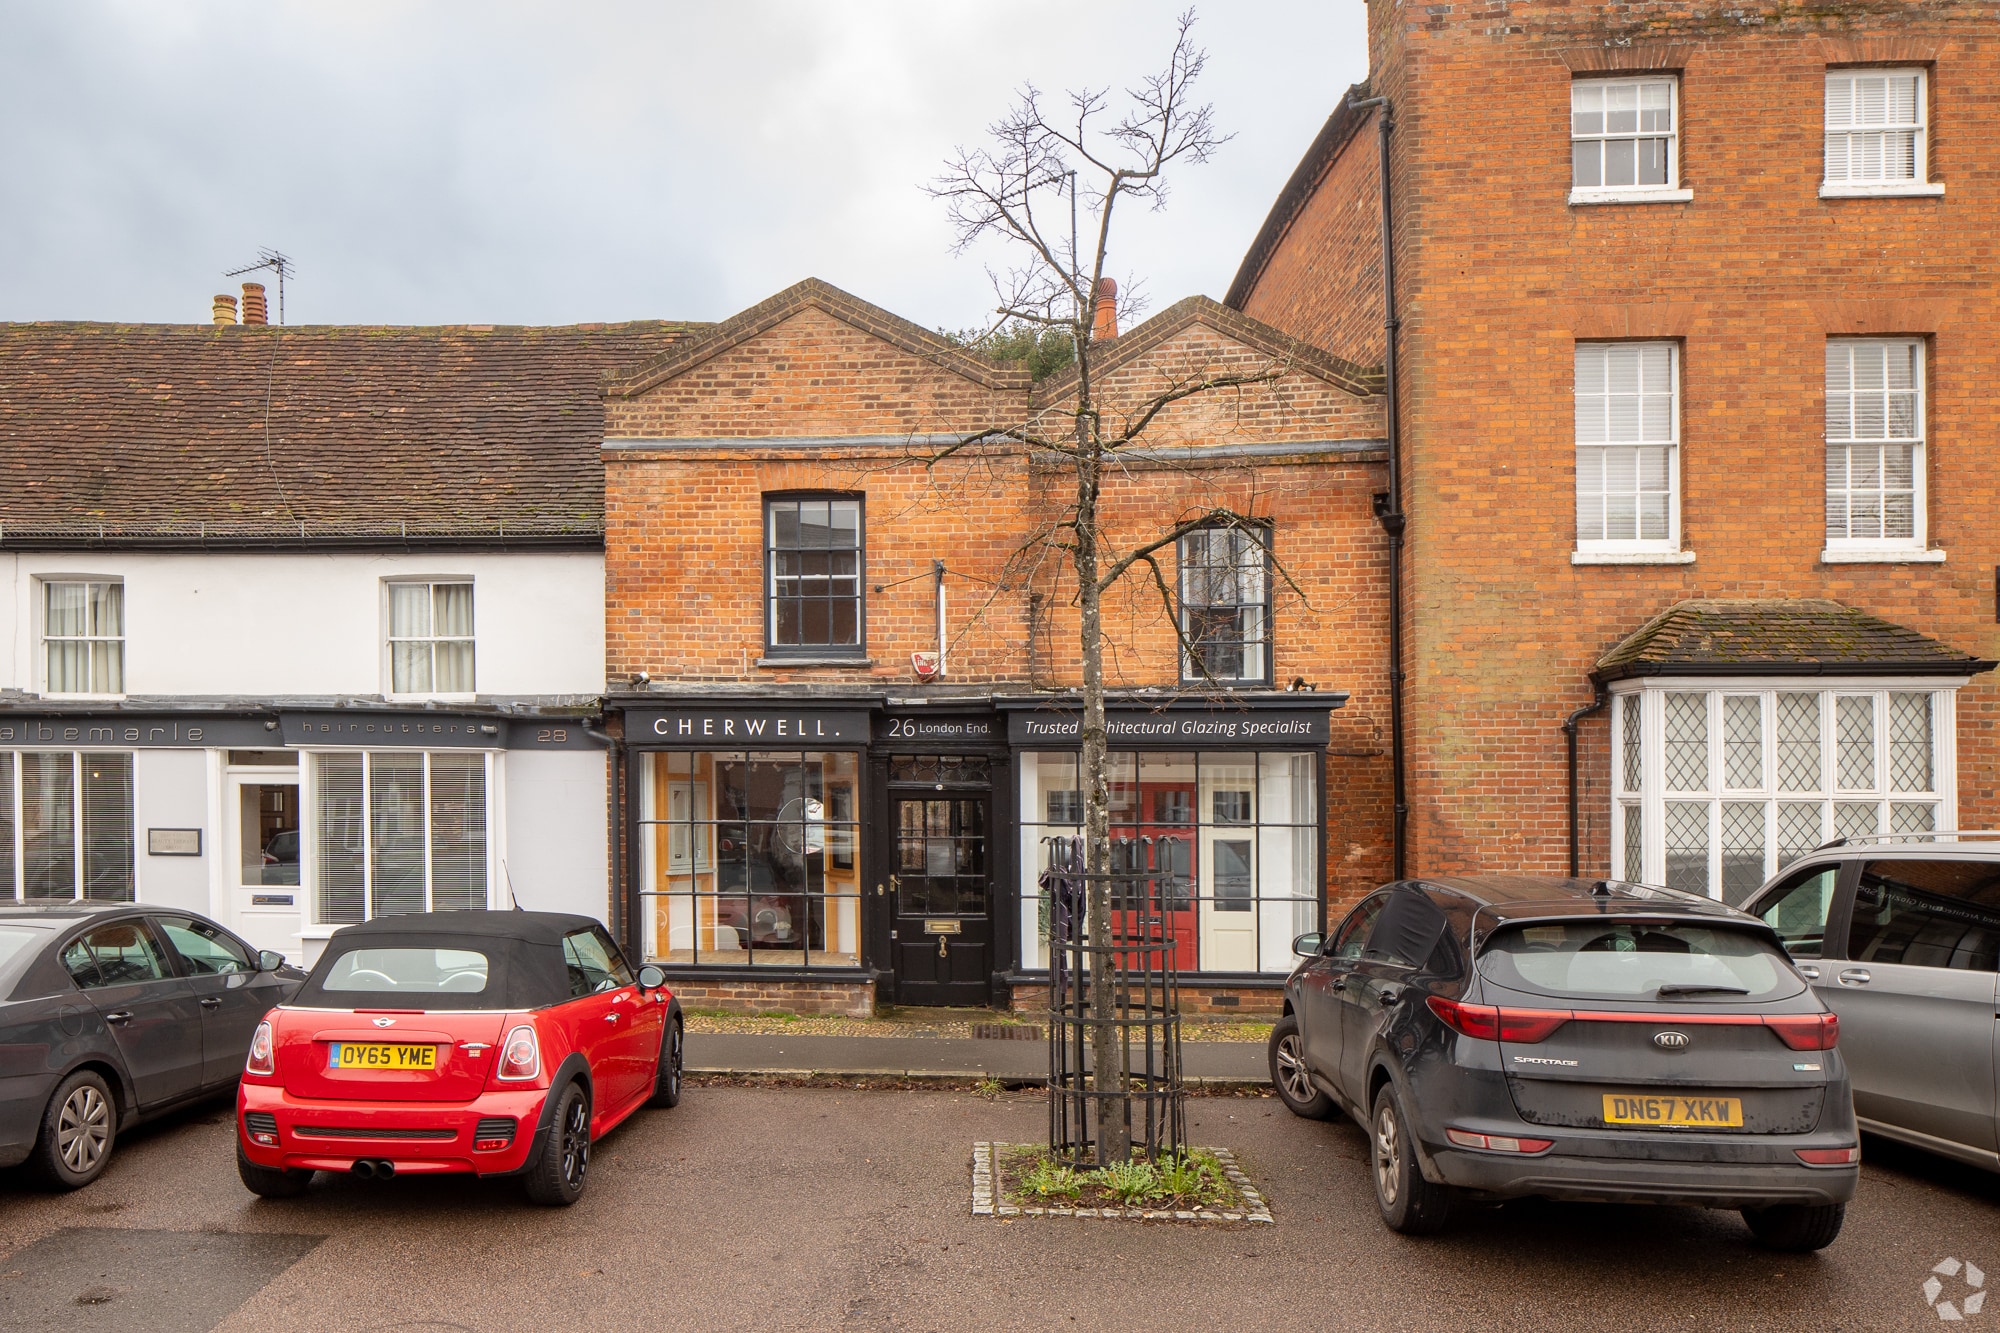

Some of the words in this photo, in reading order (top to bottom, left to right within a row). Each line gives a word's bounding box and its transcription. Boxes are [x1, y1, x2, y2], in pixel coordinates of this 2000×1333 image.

[0, 720, 204, 742] albemarle
[302, 721, 476, 734] haircutters
[537, 729, 567, 742] 28
[653, 718, 841, 737] CHERWELL.
[888, 718, 916, 738] 26
[919, 722, 963, 734] London
[966, 722, 992, 734] End.
[1025, 720, 1079, 735] Trusted
[1103, 720, 1177, 735] hitectural
[1180, 720, 1238, 738] Glazing
[1241, 719, 1312, 737] Specialist
[1660, 1035, 1685, 1047] KIA
[343, 1046, 391, 1065] OY65
[397, 1047, 434, 1066] YME
[1513, 1056, 1579, 1067] SPORTAGE
[1613, 1098, 1676, 1121] DN67
[1681, 1100, 1730, 1122] XKW
